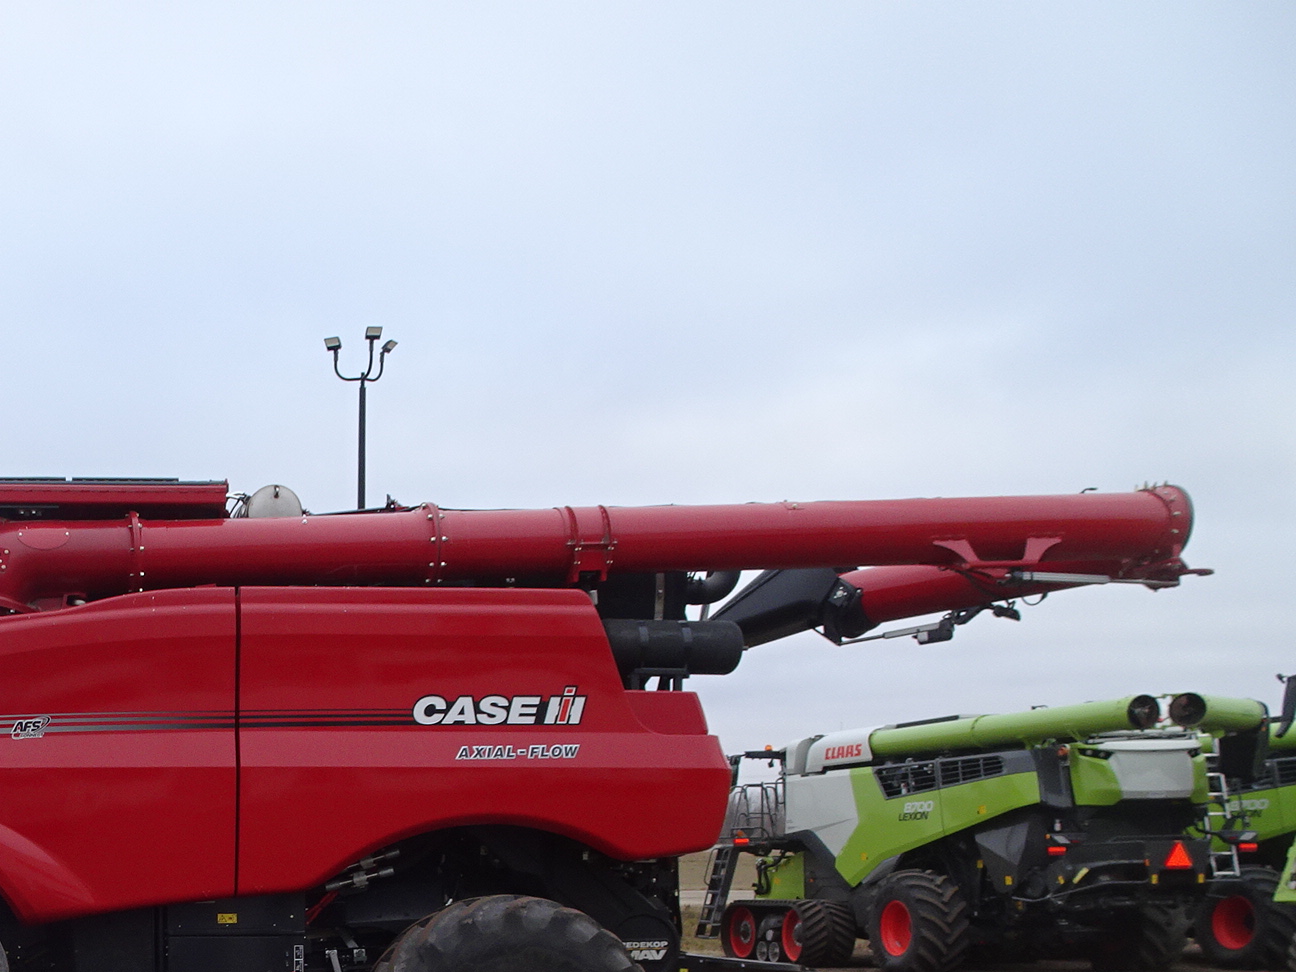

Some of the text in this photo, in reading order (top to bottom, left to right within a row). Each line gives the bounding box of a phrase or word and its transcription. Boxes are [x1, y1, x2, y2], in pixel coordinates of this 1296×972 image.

[412, 695, 542, 725] CASE
[11, 719, 43, 733] AFS
[455, 744, 580, 760] AXIAL-FLOW
[825, 744, 862, 760] CLAAS
[904, 801, 934, 813] 8700
[898, 811, 929, 821] LEXION
